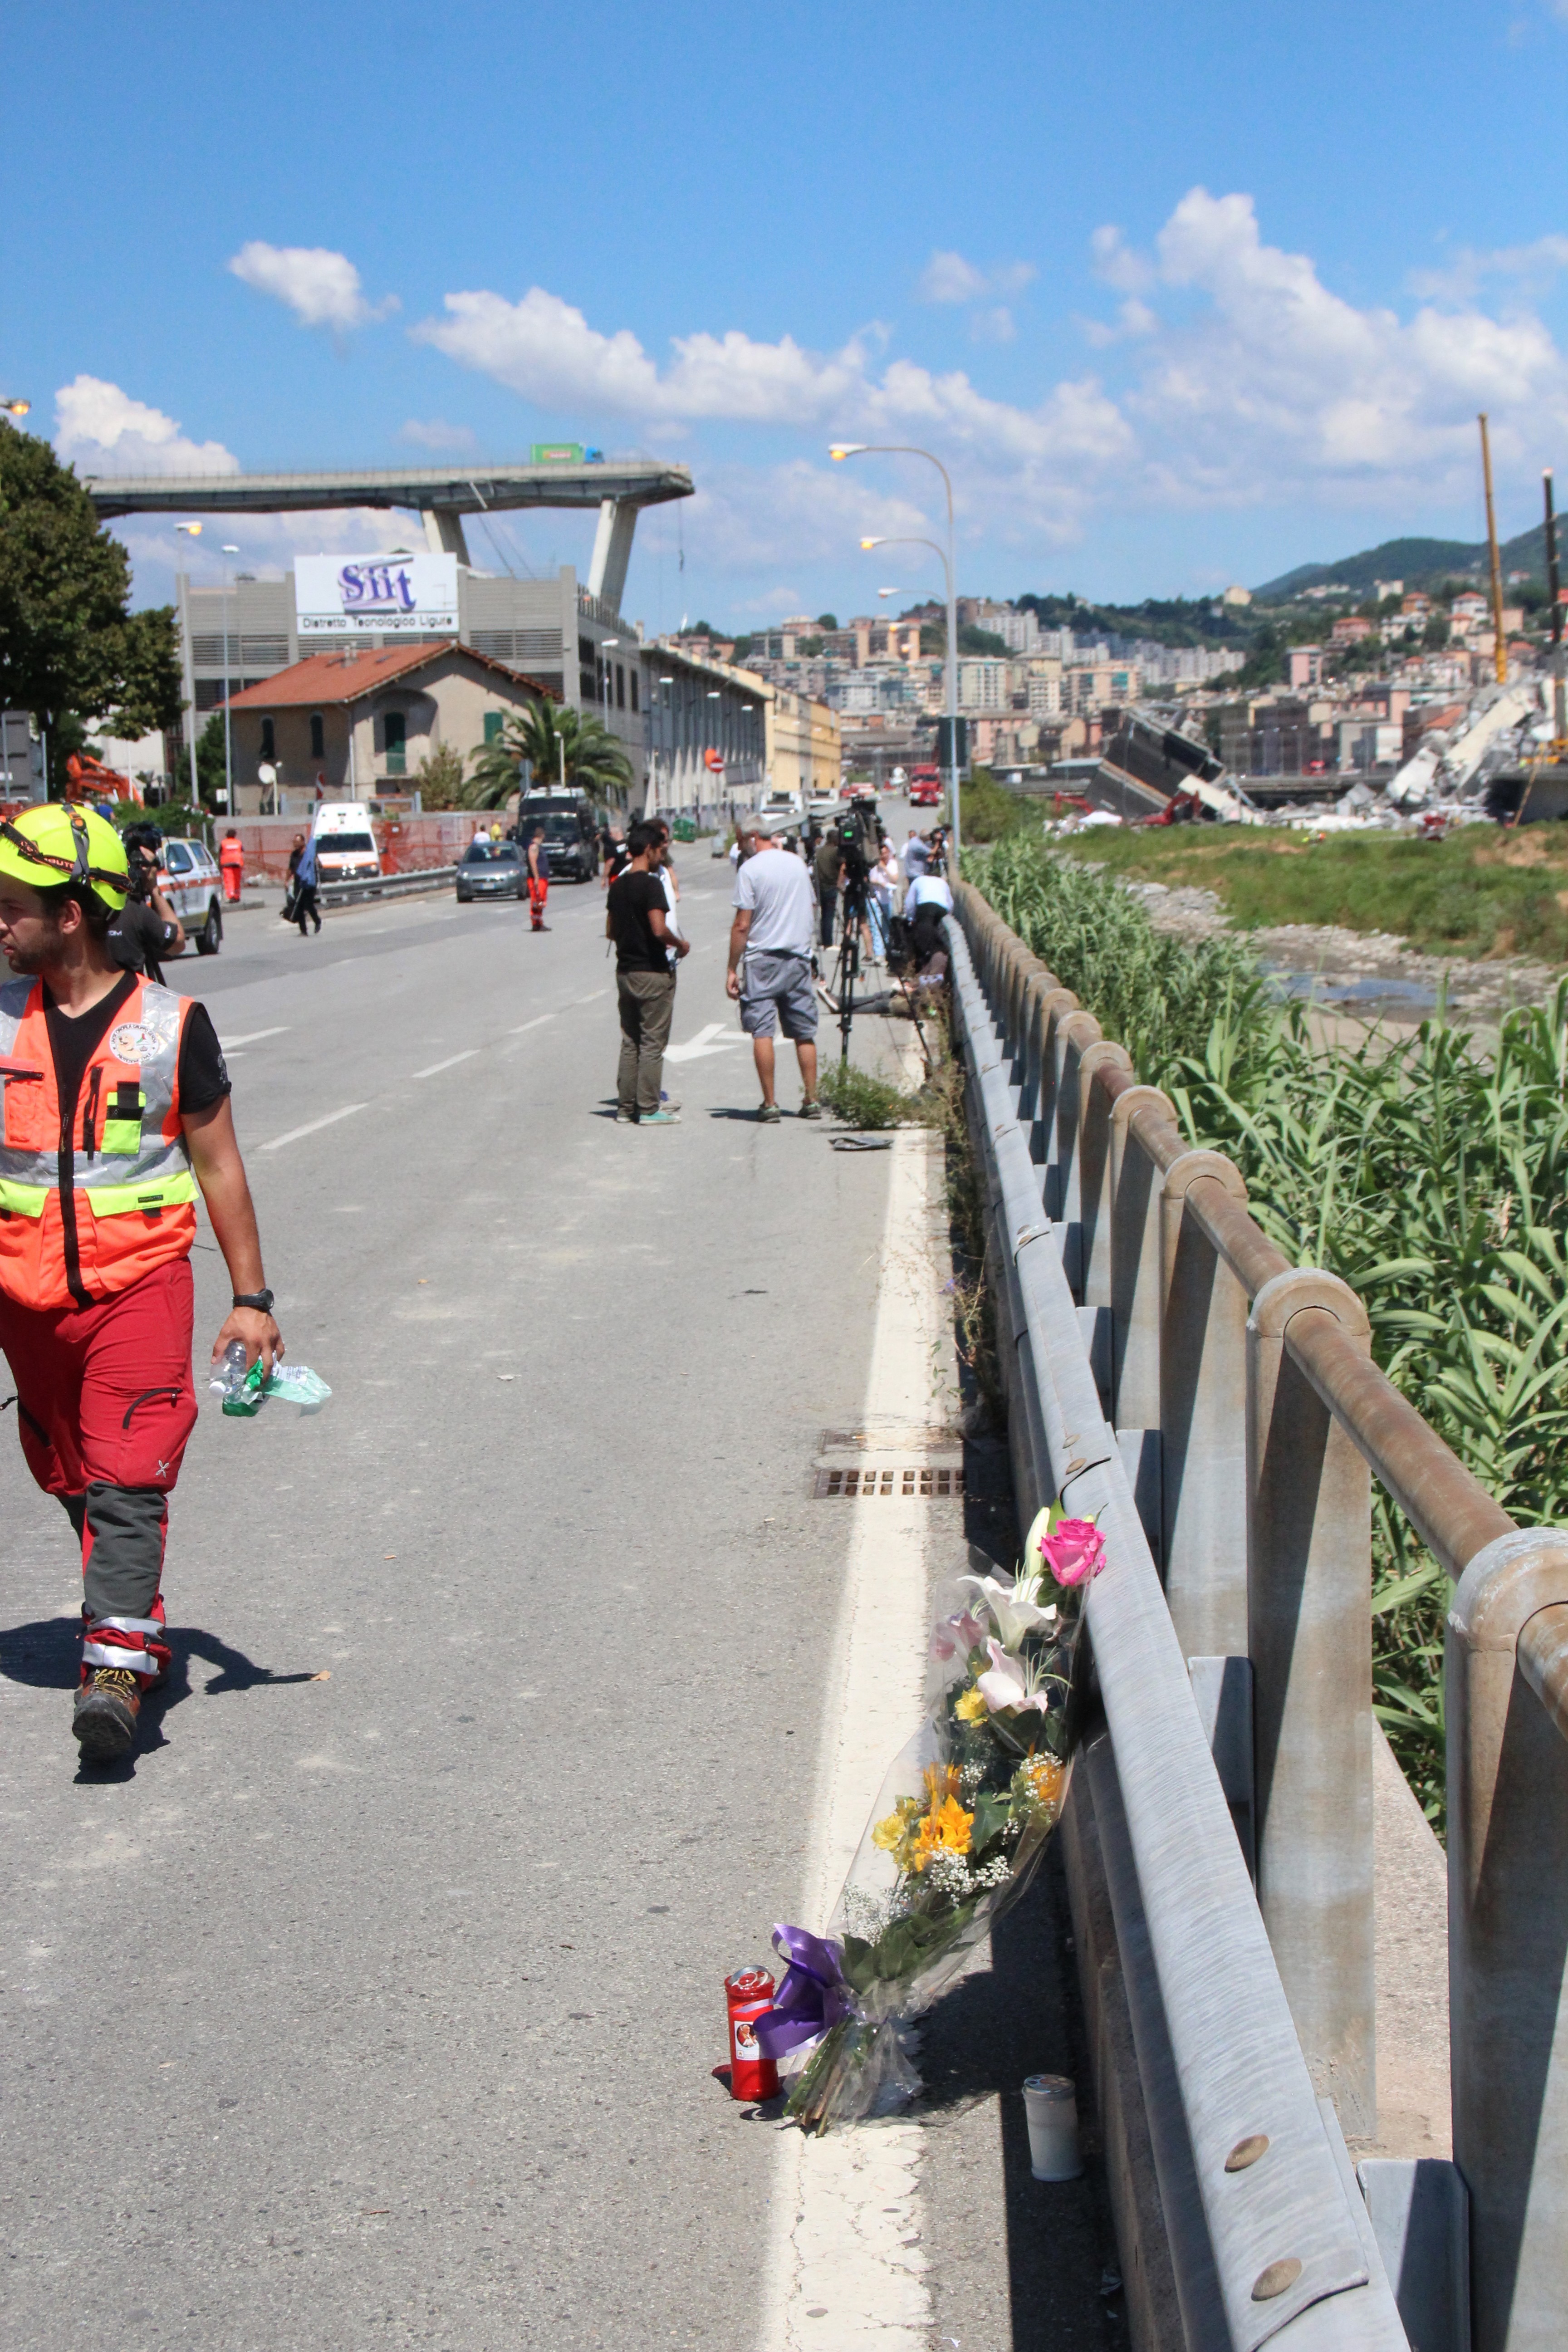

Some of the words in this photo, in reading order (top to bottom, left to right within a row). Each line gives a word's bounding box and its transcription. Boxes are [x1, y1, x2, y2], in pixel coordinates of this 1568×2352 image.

[338, 564, 417, 613] Siit
[303, 617, 346, 628] Distretto
[353, 615, 415, 629] Tecnologico
[420, 615, 452, 628] Ligure
